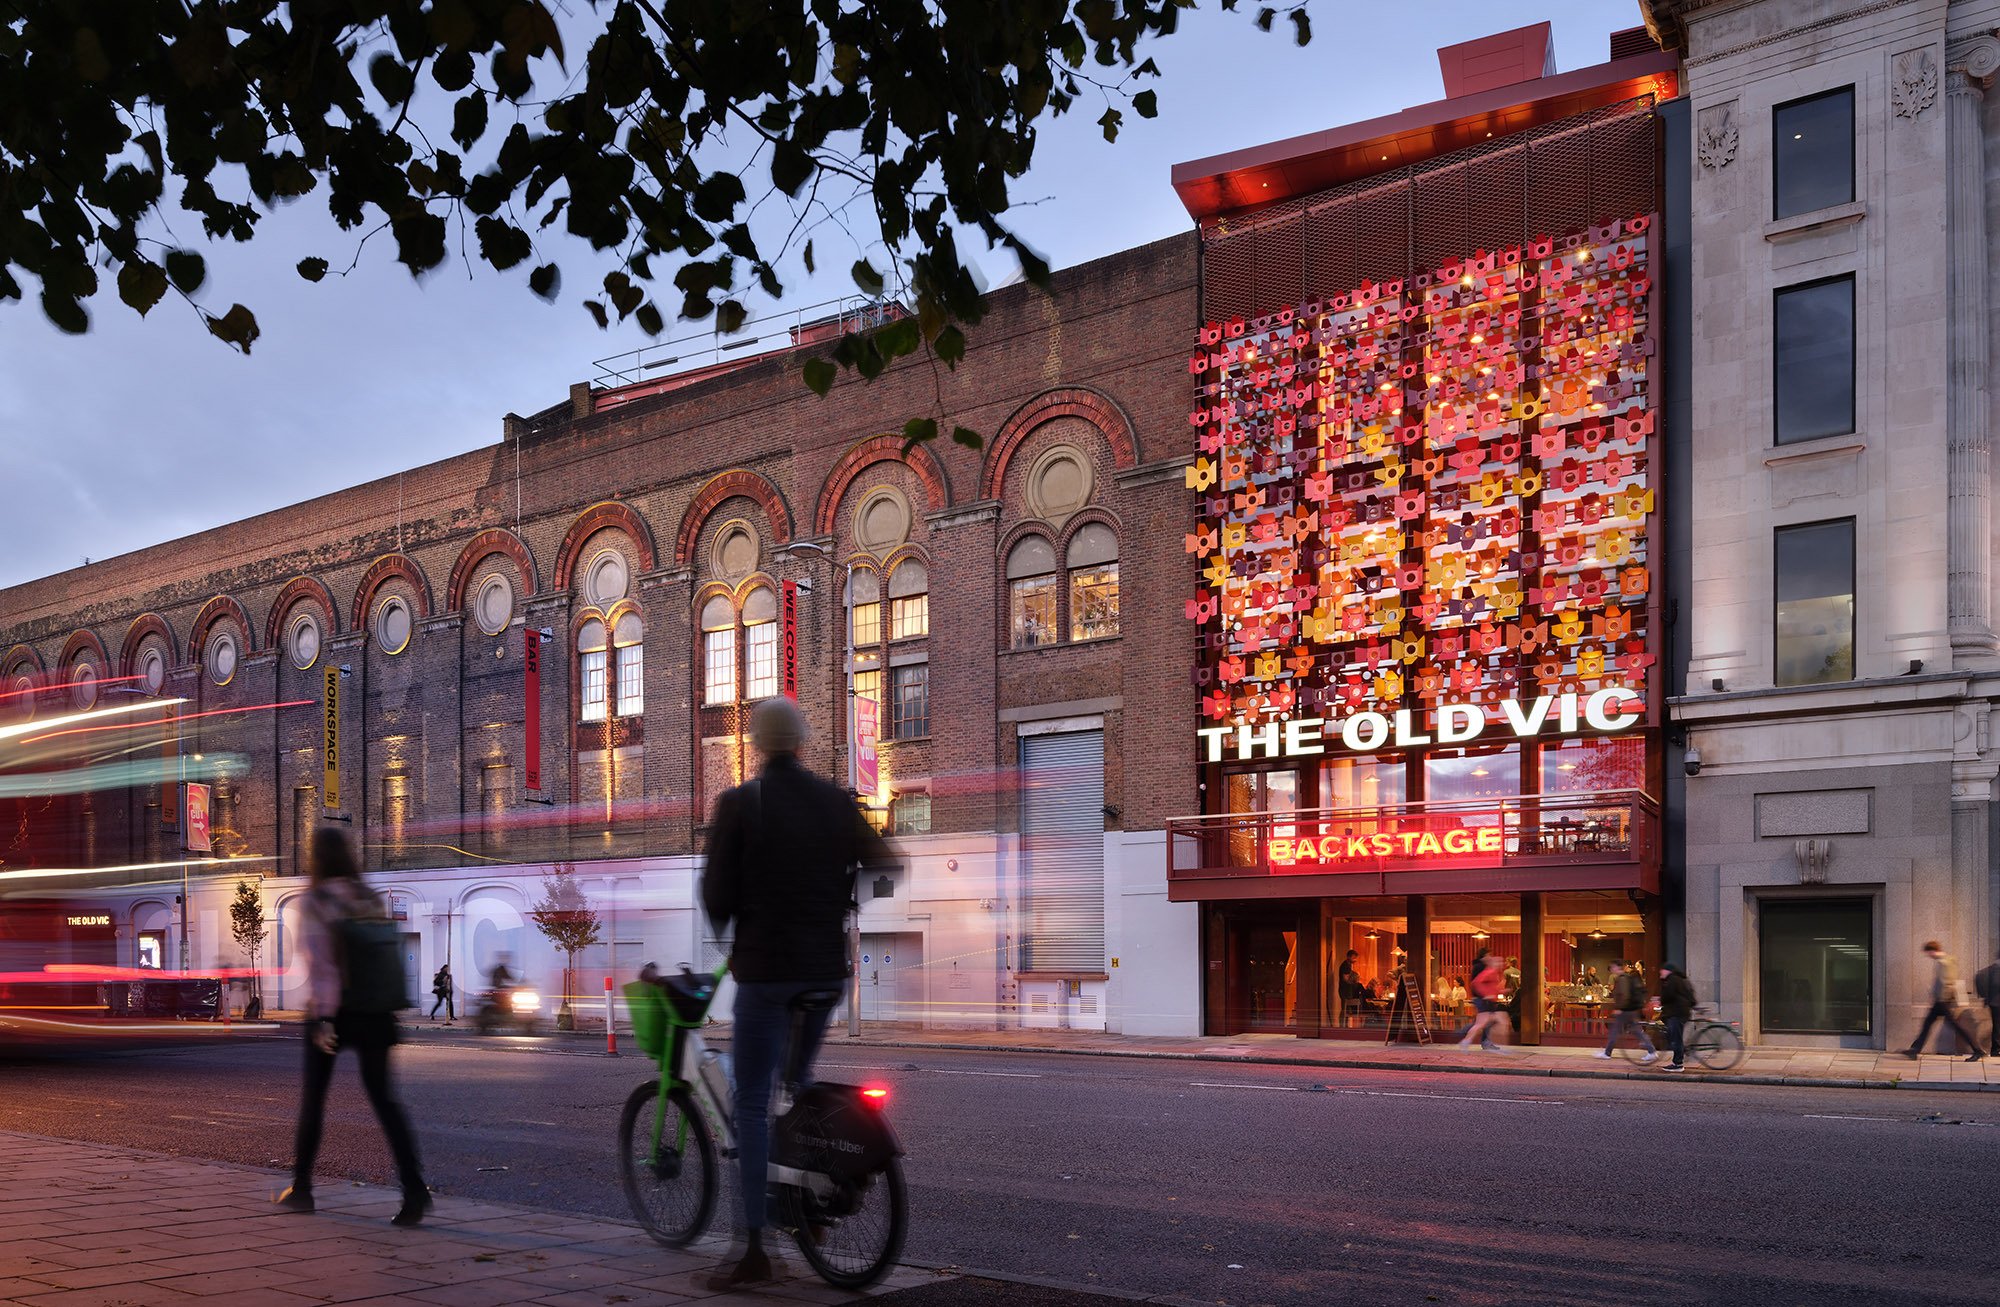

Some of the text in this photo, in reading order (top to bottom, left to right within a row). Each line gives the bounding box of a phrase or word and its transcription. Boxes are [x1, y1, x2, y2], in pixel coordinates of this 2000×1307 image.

[528, 635, 537, 673] BAR
[786, 589, 794, 692] WELCOME
[327, 672, 336, 771] WORKSPACE
[1197, 687, 1640, 763] THE OLD VIC
[190, 809, 204, 819] CUT
[1269, 827, 1502, 861] BACKSTAGE
[67, 915, 110, 926] THE OLD VIC
[839, 1139, 865, 1154] Uber
